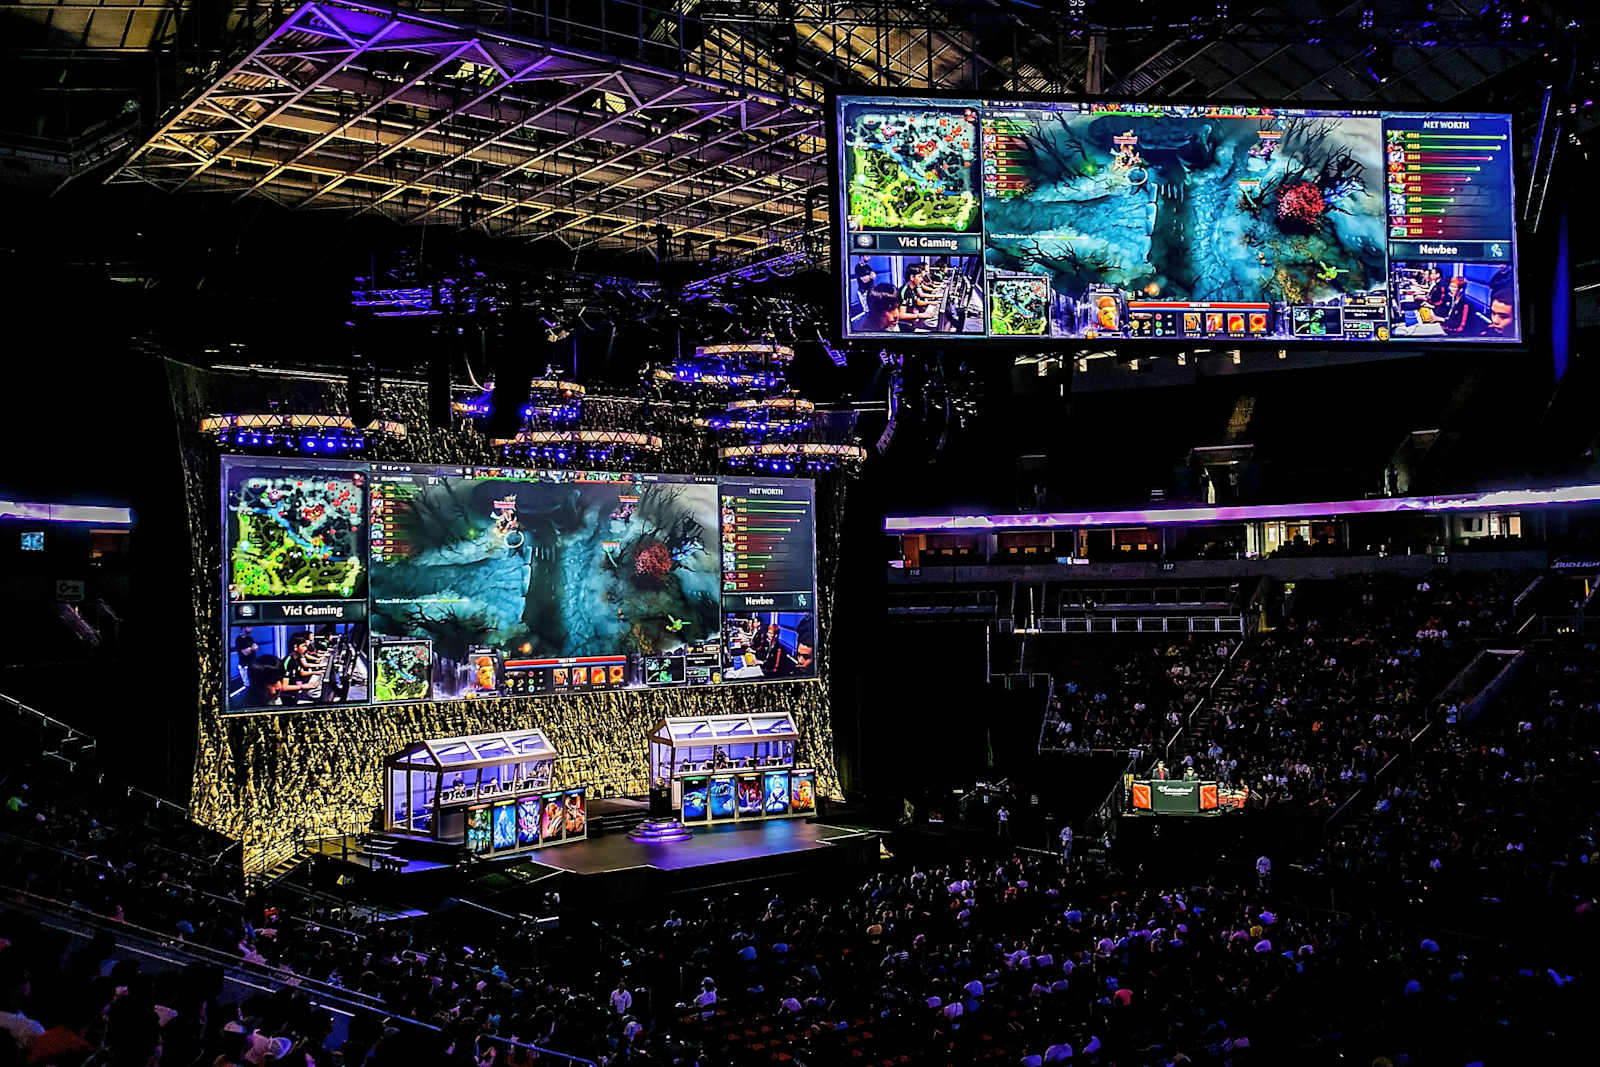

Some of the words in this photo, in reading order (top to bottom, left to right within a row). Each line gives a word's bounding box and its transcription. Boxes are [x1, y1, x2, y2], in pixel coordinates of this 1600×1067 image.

[1423, 121, 1440, 129] NET
[1440, 121, 1470, 129] WORTH
[898, 237, 918, 248] Vici
[919, 237, 958, 250] Gaming
[1419, 244, 1458, 254] Newbee
[761, 488, 784, 496] WORTH
[745, 596, 774, 605] Newbee
[282, 605, 303, 616] Vici
[304, 605, 344, 617] Gaming
